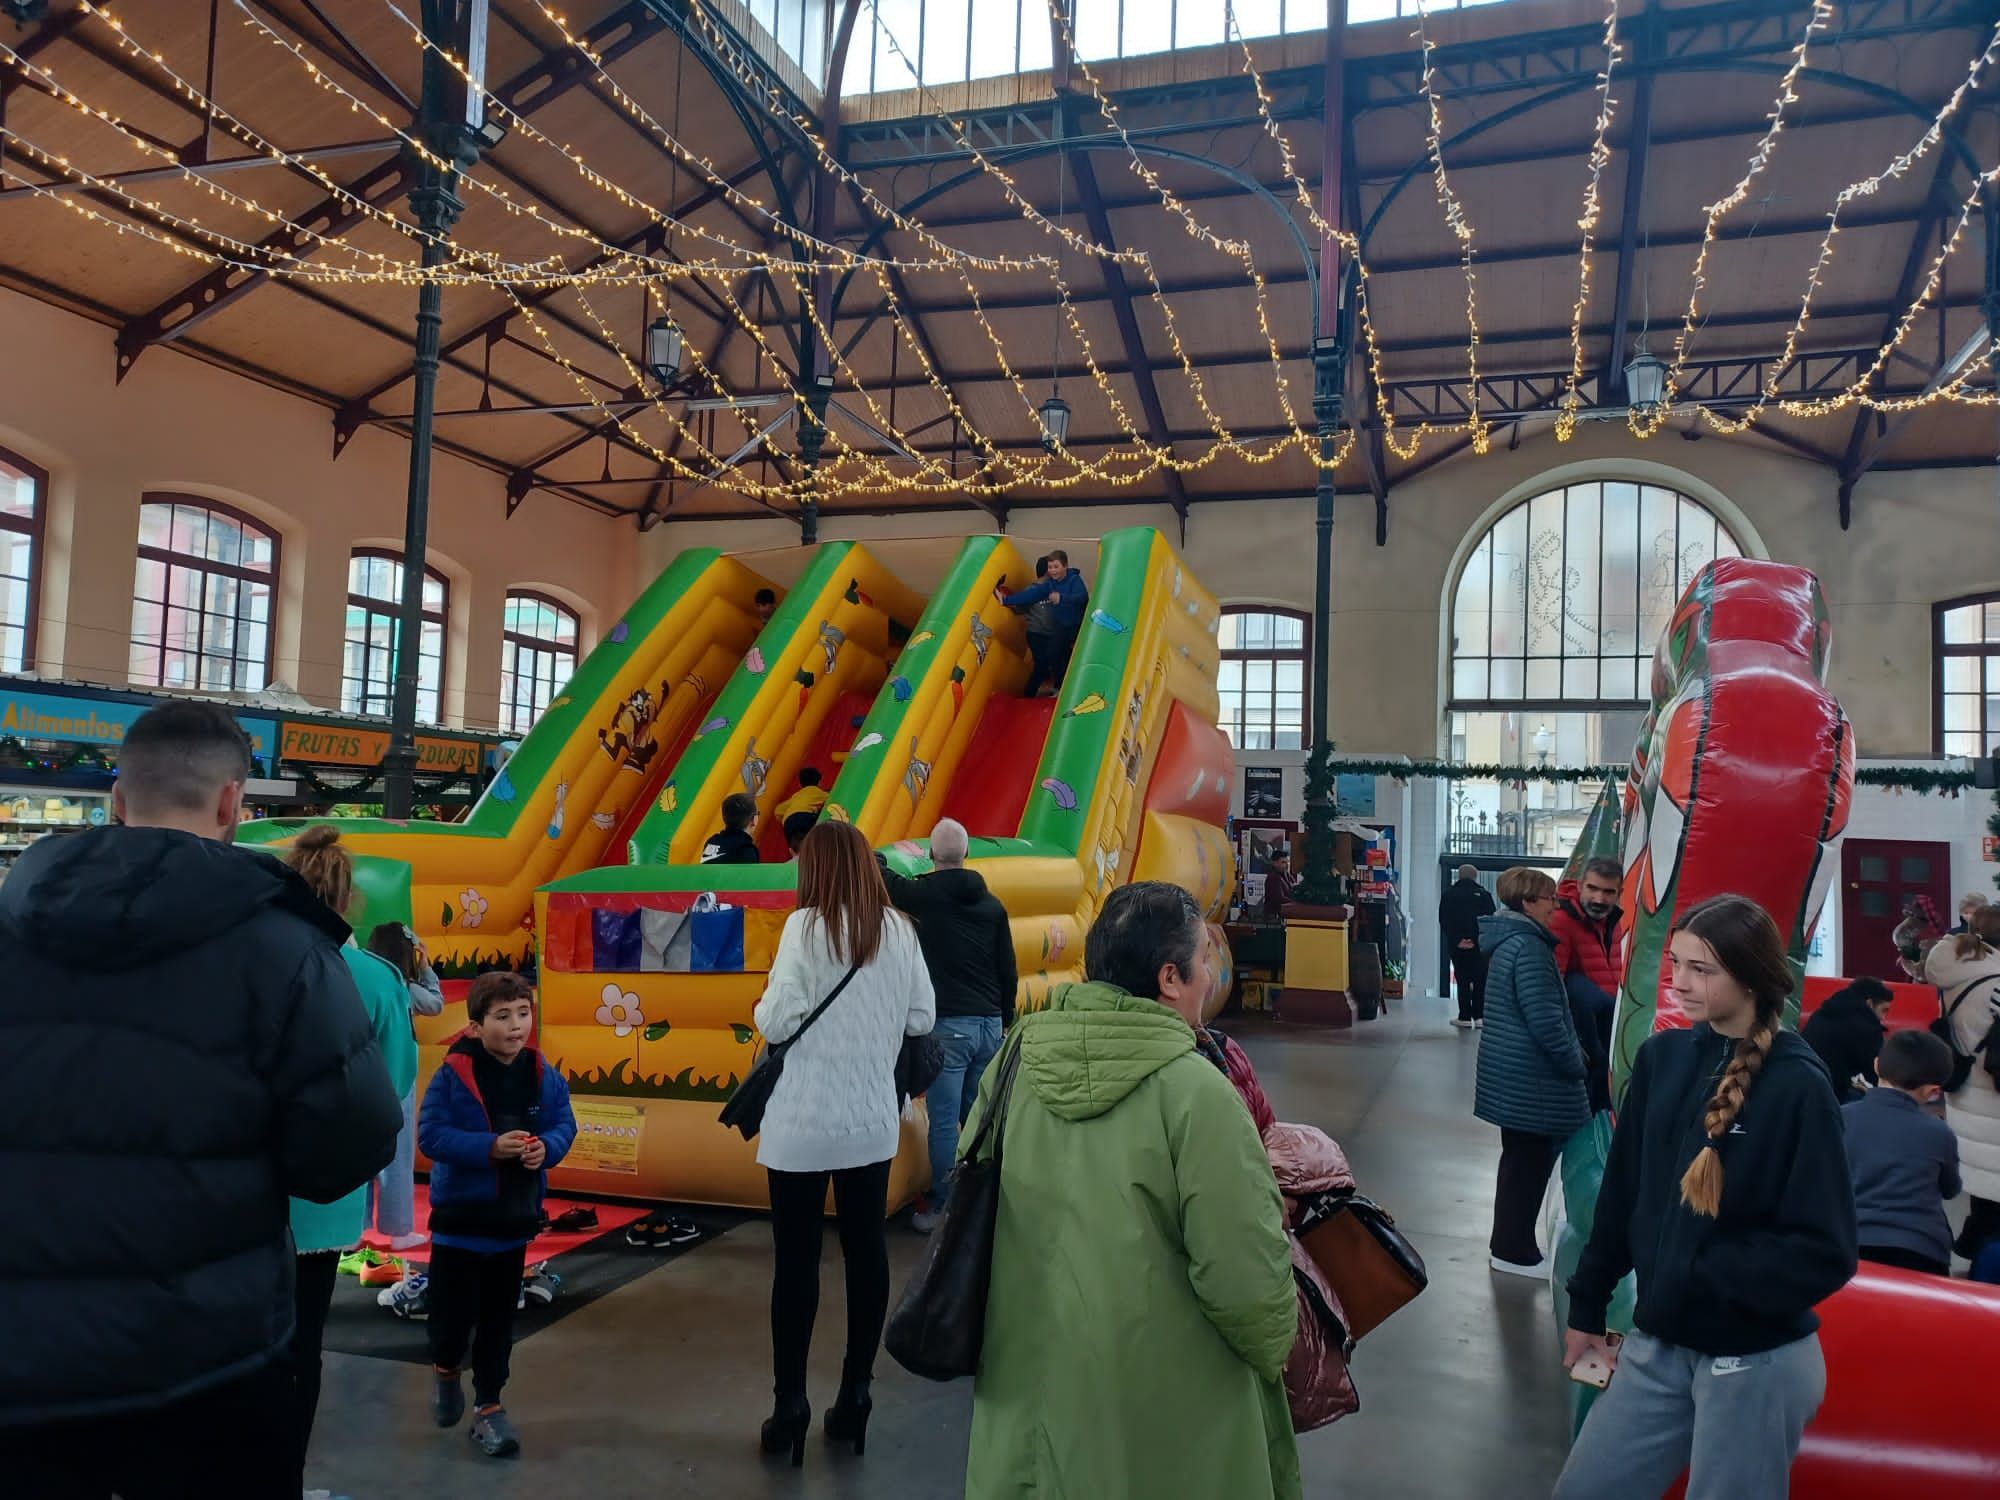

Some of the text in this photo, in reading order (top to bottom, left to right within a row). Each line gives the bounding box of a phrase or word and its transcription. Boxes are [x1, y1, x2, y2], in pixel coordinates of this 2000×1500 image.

[2, 701, 125, 740] Alimentos
[284, 730, 361, 757] FRUTAS
[1714, 1356, 1742, 1369] NIKE
